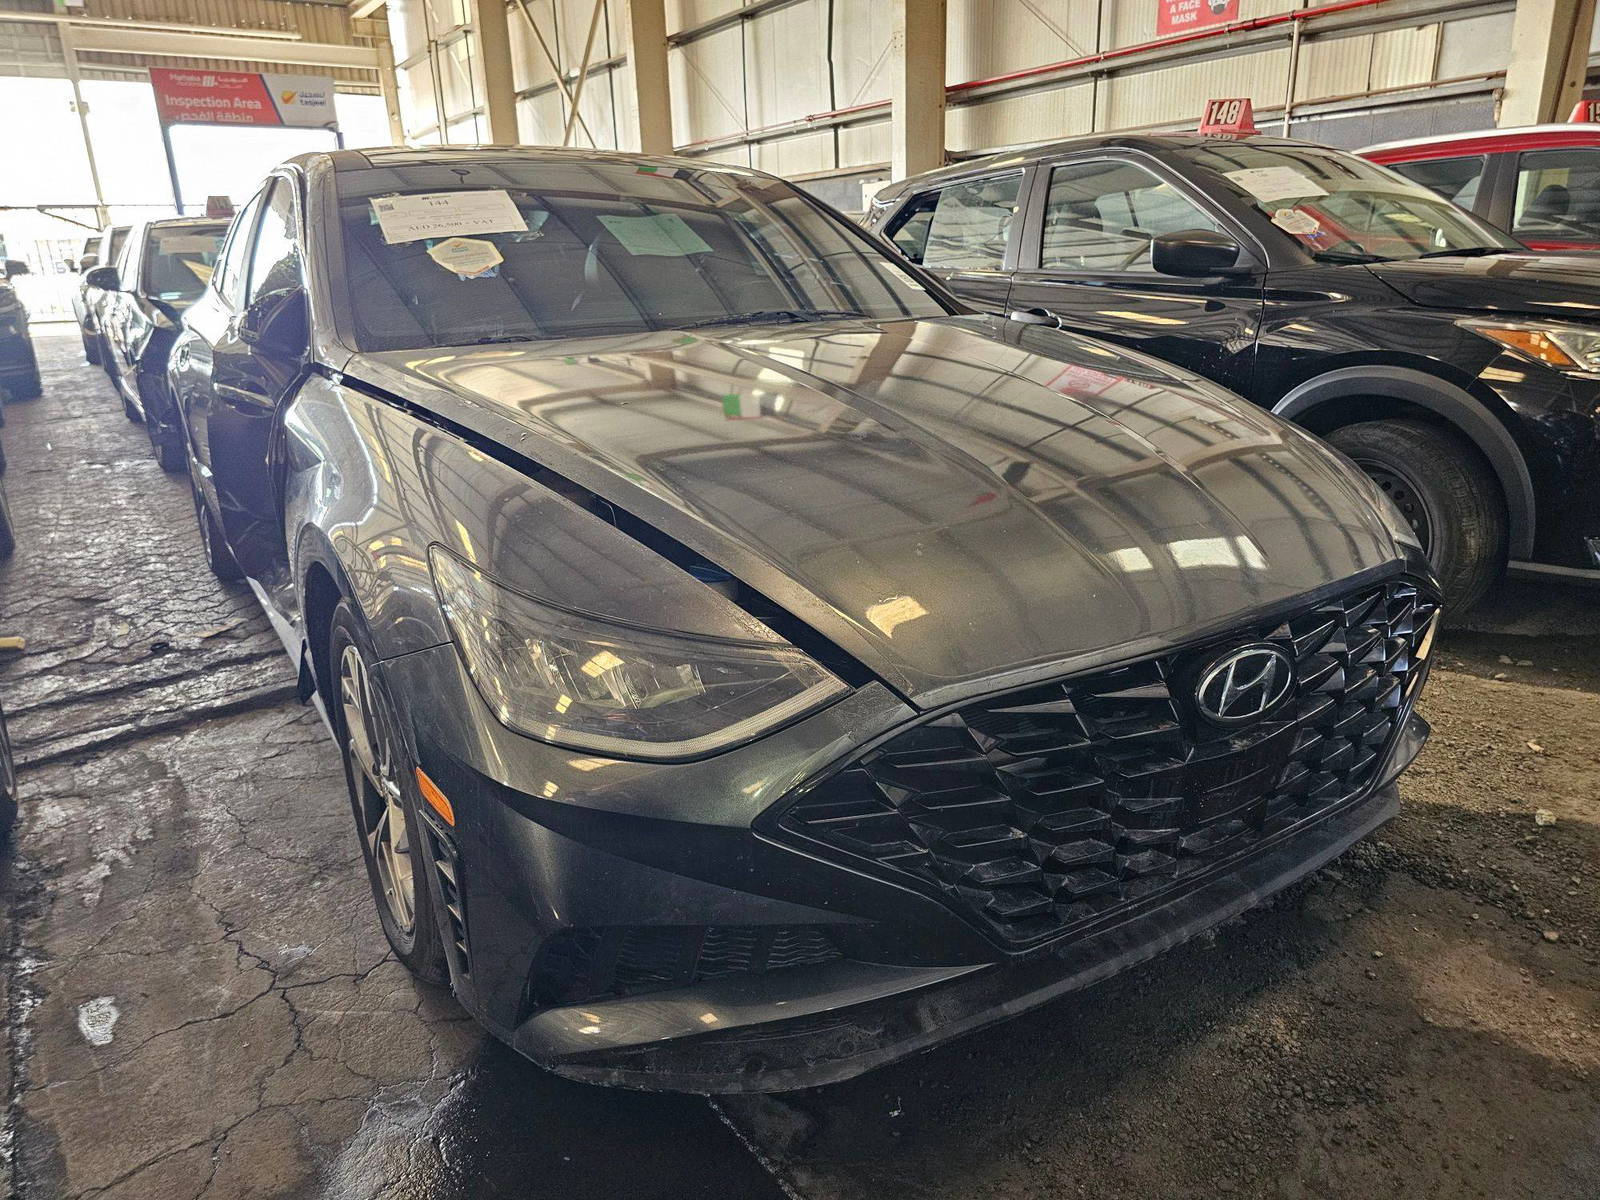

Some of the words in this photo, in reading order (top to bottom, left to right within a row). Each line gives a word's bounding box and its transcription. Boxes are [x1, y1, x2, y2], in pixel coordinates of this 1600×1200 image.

[1169, 4, 1177, 14] A
[1178, 0, 1201, 11] FACE
[1171, 11, 1198, 25] MASK
[165, 94, 232, 109] Inspection
[233, 97, 263, 110] Area
[1209, 100, 1241, 126] 148
